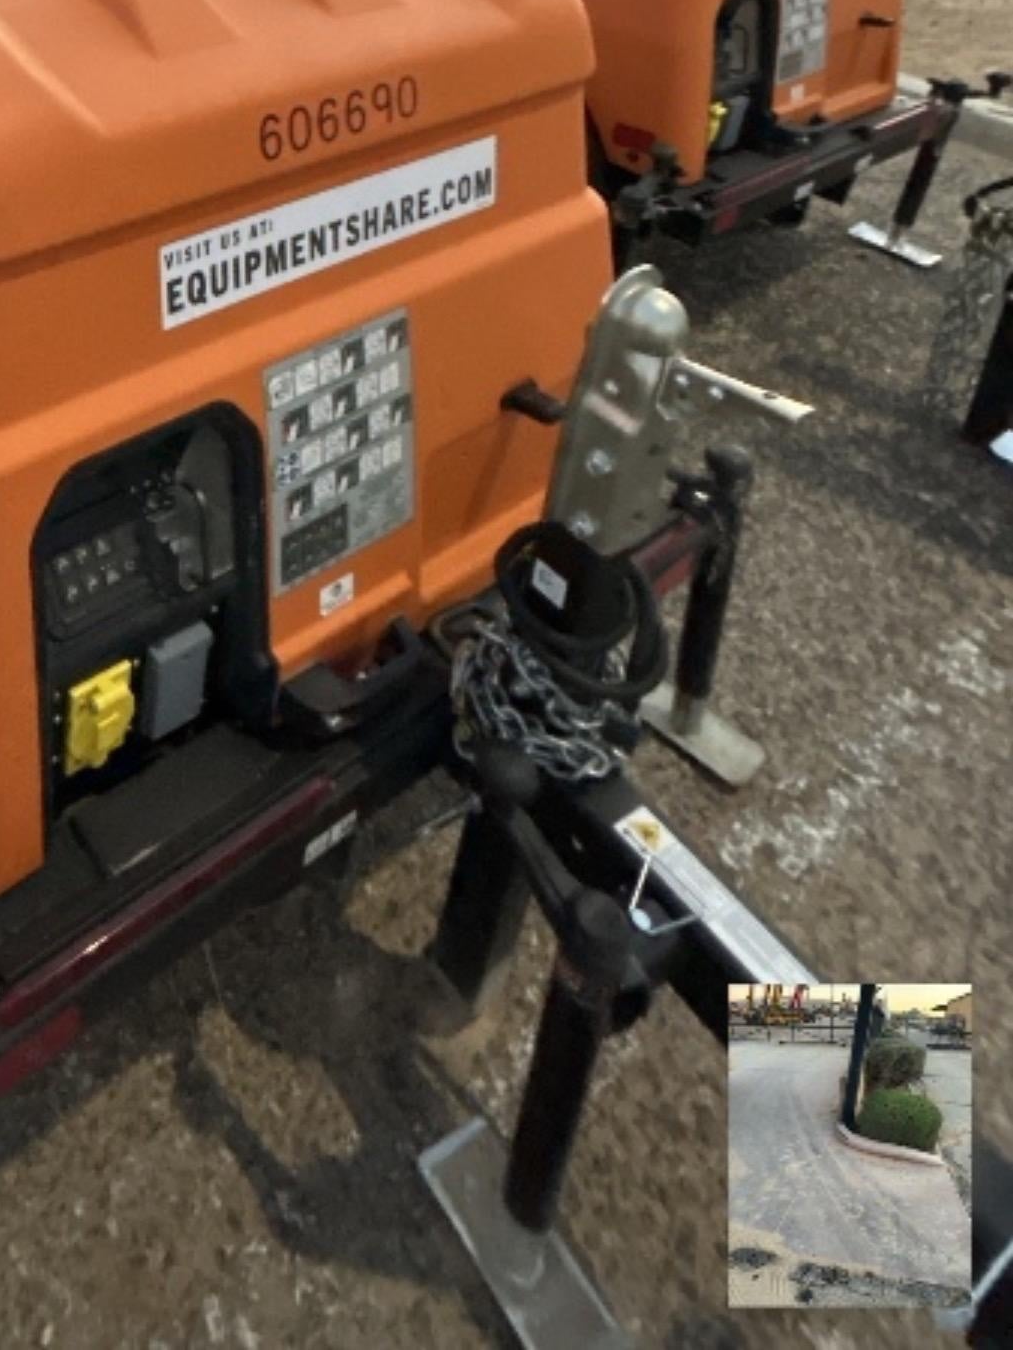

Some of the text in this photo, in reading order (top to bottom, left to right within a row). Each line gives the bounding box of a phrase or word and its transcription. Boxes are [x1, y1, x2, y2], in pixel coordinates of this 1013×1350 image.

[260, 75, 419, 161] 606690
[164, 239, 211, 270] VISIT
[220, 228, 240, 250] US
[166, 167, 492, 315] EQUIPMENTSHARE.COM
